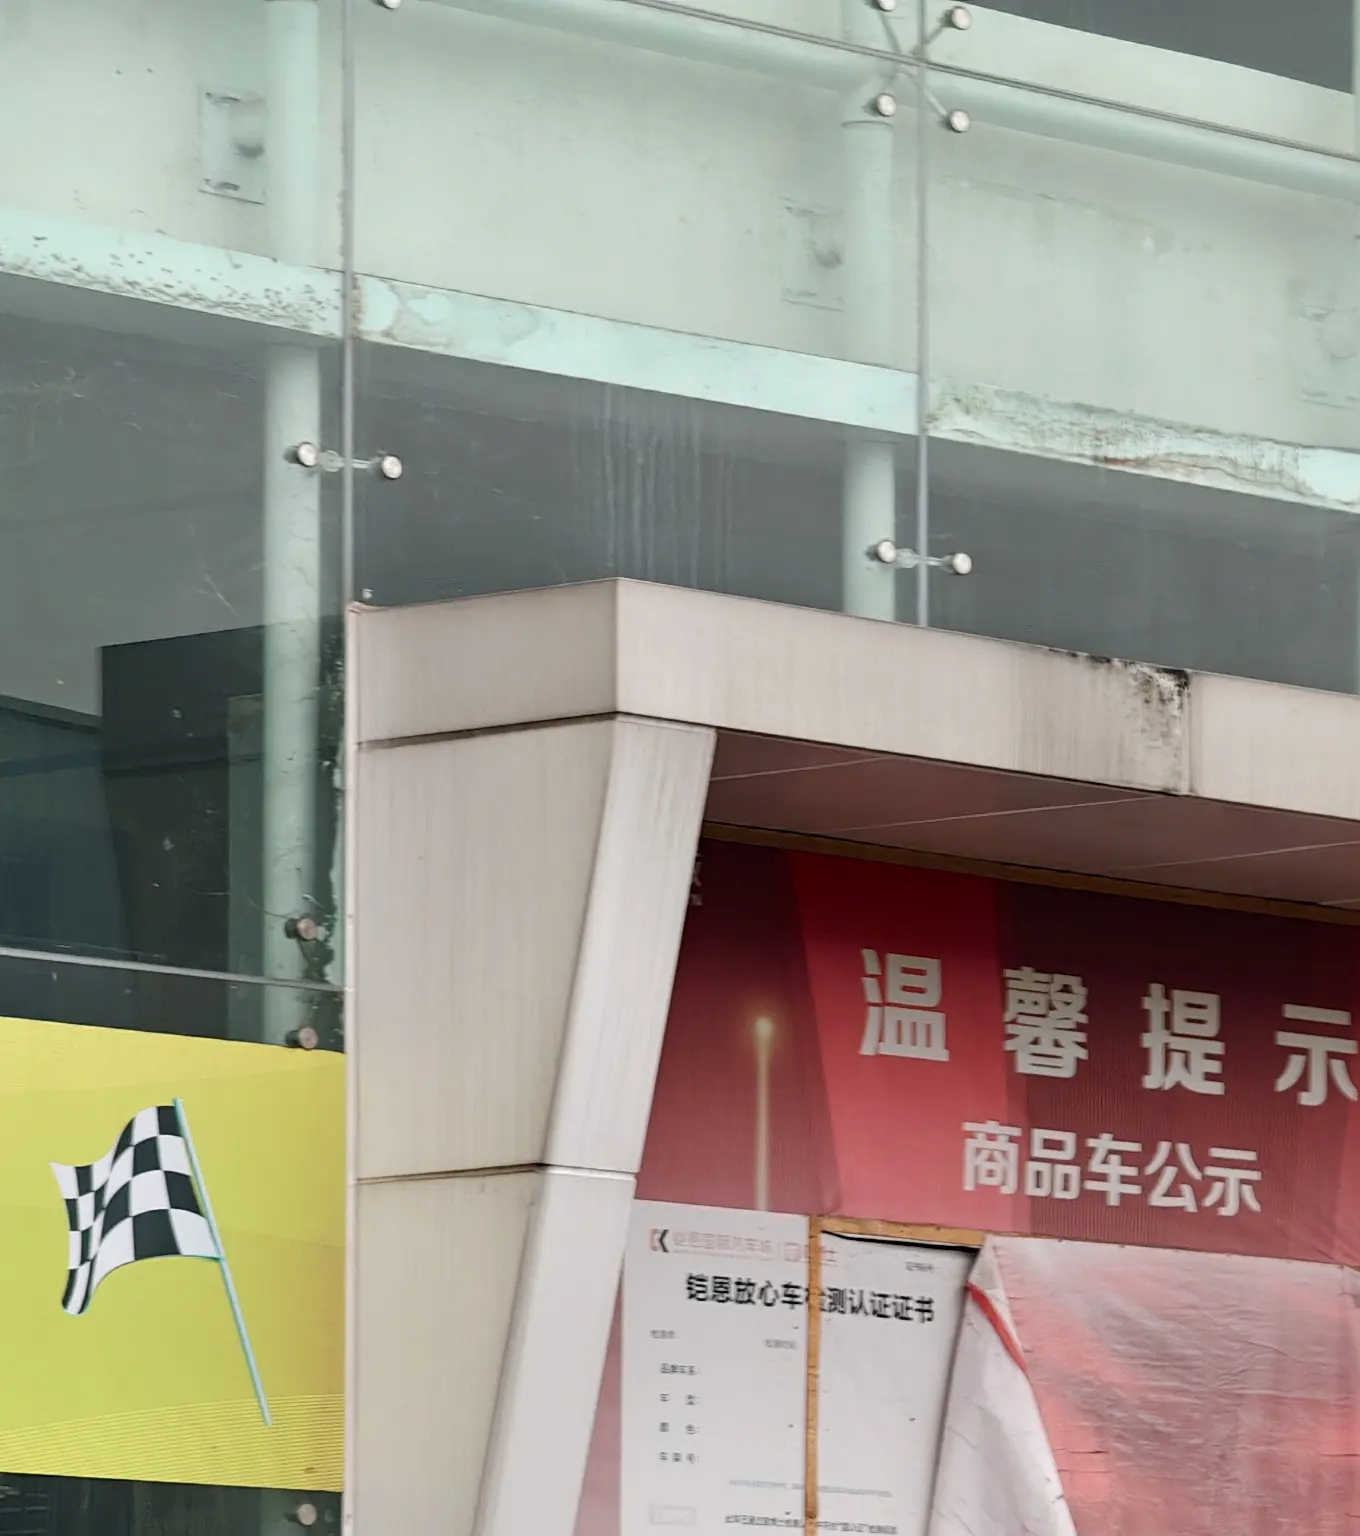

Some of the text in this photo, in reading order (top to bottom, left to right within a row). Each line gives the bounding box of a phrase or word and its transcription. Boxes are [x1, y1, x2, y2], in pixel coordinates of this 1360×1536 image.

[858, 948, 1360, 1106] 温馨提示
[962, 1119, 1262, 1217] 商品车公示
